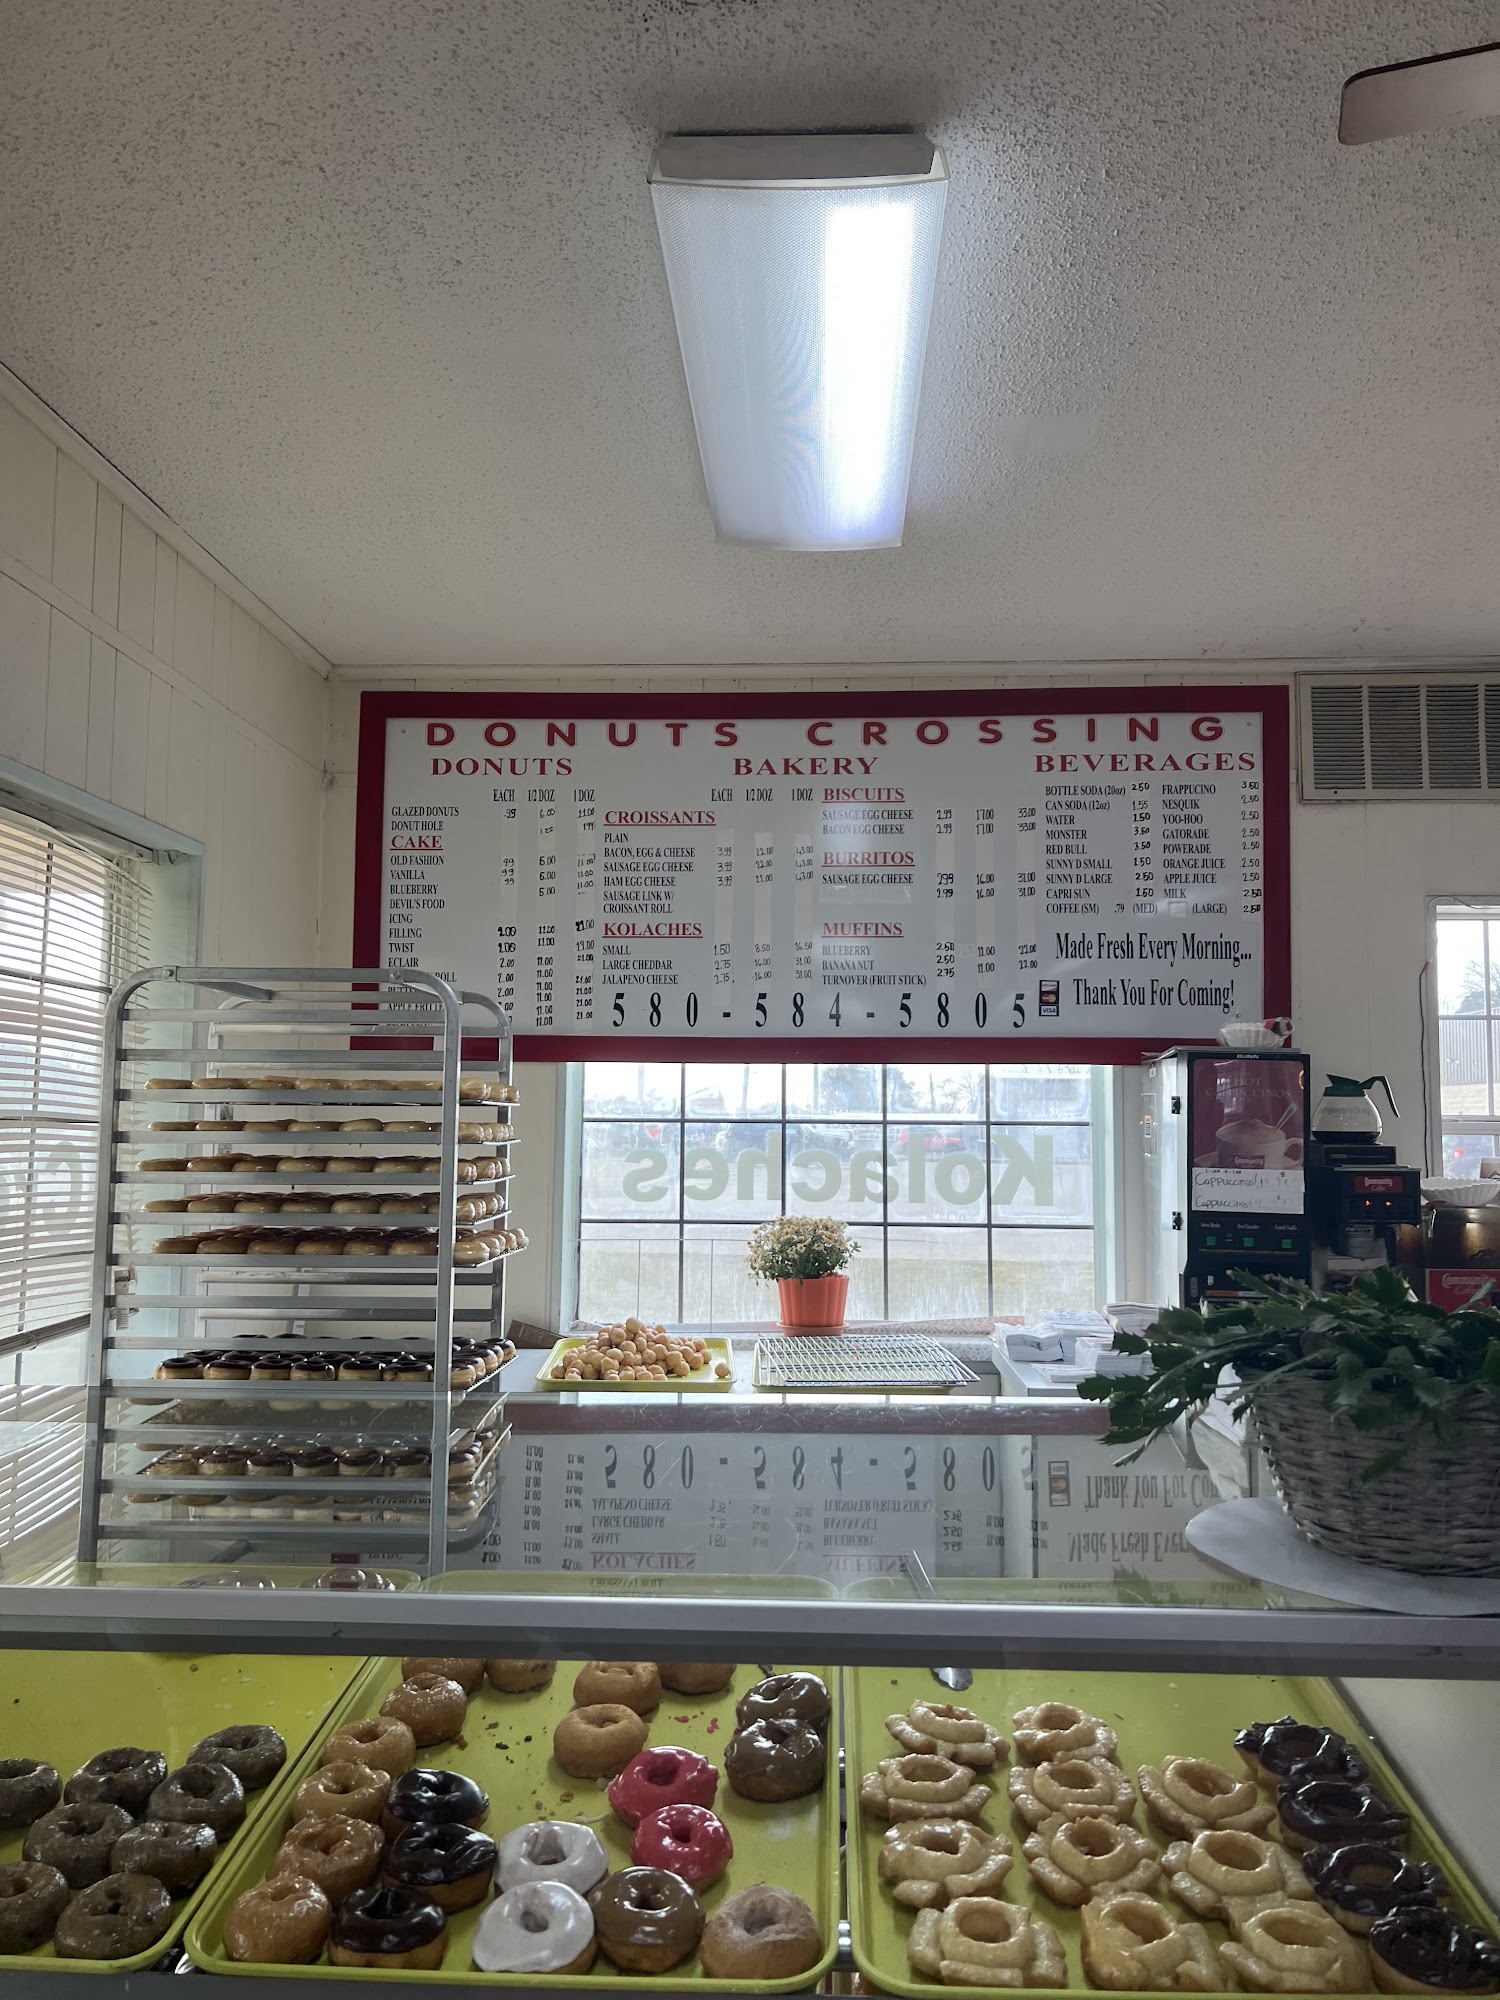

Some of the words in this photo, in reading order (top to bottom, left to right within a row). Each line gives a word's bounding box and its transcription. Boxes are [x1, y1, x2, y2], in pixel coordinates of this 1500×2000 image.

[426, 721, 739, 748] DONUTS
[806, 716, 1225, 746] CROSSING
[431, 758, 572, 776] DONUTS
[733, 757, 879, 777] BAKERY
[1034, 753, 1255, 773] BEVERAGES
[824, 788, 904, 800] BISCUITS
[1046, 786, 1079, 796] BOTTLE
[1081, 786, 1103, 795] SODA
[1162, 784, 1216, 794] FRAPPUCINO
[493, 789, 515, 801] EACH
[528, 789, 537, 801] 1/2
[539, 789, 555, 801] DOZ
[579, 789, 595, 801] DOZ
[712, 789, 733, 801] EACH
[746, 789, 756, 801] 1/2
[757, 789, 773, 801] DOZ
[797, 789, 813, 801] DOZ
[1046, 801, 1063, 810] CAN
[1065, 801, 1087, 810] SODA
[1162, 799, 1200, 811] NESQUIK
[392, 806, 424, 816] GLAZED
[427, 806, 459, 816] DONUTS
[823, 810, 860, 820] SAUSAGE
[862, 810, 880, 820] EGG
[881, 810, 913, 820] CHEESE
[605, 811, 715, 824] CROISSANTS
[1046, 815, 1075, 825] WATER
[1162, 814, 1203, 824] YOO-HOO
[391, 821, 419, 831] DONUT
[421, 821, 444, 831] HOLE
[823, 825, 851, 834] BACON
[853, 825, 871, 834] EGG
[873, 825, 904, 834] CHEESE
[604, 833, 629, 843] PLAIN
[1046, 830, 1087, 840] MONSTER
[1163, 829, 1209, 839] GATORADE
[391, 835, 442, 848] CAKE
[604, 848, 635, 858] BACON,
[636, 848, 654, 857] EGG
[656, 848, 661, 857] &
[664, 848, 695, 857] CHEESE
[1046, 845, 1063, 854] RED
[1065, 845, 1087, 854] BULL
[1163, 844, 1211, 854] POWERADE
[390, 855, 407, 865] OLD
[409, 855, 444, 865] FASHION
[824, 851, 914, 865] BURRITOS
[604, 862, 641, 872] SAUSAGE
[643, 862, 660, 872] EGG
[662, 862, 693, 872] CHEESE
[1046, 859, 1074, 869] SUNNY
[1076, 859, 1082, 869] D
[1084, 859, 1113, 869] SMALL
[1163, 859, 1199, 869] ORANGE
[1200, 859, 1226, 869] JUICE
[391, 870, 425, 880] VANILLA
[822, 874, 860, 884] SAUSAGE
[862, 874, 879, 884] EGG
[881, 874, 913, 884] CHEESE
[1046, 874, 1074, 884] SUNNY
[1076, 874, 1082, 884] D
[1084, 874, 1113, 884] LARGE
[1163, 874, 1191, 884] APPLE
[1192, 874, 1217, 884] JUICE
[604, 877, 623, 886] HAM
[625, 877, 642, 886] EGG
[644, 877, 675, 886] CHEESE
[390, 885, 438, 894] BLUEBERRY
[1046, 889, 1072, 899] CAPRI
[1074, 889, 1090, 898] SUN
[1164, 889, 1186, 898] MILK
[603, 891, 641, 901] SAUSAGE
[642, 891, 662, 901] LINK
[390, 899, 420, 909] DEVIL'S
[422, 899, 445, 909] FOOD
[604, 904, 650, 914] CROISSANT
[652, 904, 673, 914] ROLL
[1047, 903, 1080, 913] COFFEE
[1081, 903, 1099, 915] (SM)
[1133, 903, 1157, 914] (MED)
[1193, 903, 1227, 914] (LARGE)
[389, 914, 413, 924] ICING
[389, 928, 422, 938] FILLING
[604, 923, 702, 936] KOLACHES
[823, 922, 903, 936] MUFFINS
[389, 943, 414, 953] TWIST
[603, 945, 631, 955] SMALL
[822, 946, 871, 955] BLUEBERRY
[1056, 933, 1093, 959] Made
[1097, 933, 1134, 959] Fresh
[1139, 933, 1178, 967] Every
[1182, 933, 1251, 967] Morning...
[388, 958, 419, 968] ECLAIR
[602, 960, 630, 970] LARGE
[632, 960, 672, 970] CHEDDAR
[822, 960, 857, 970] BANANA
[857, 960, 874, 970] NUT
[602, 975, 645, 984] JALAPENO
[646, 975, 678, 984] CHEESE
[822, 975, 869, 985] TURNOVER
[869, 975, 897, 987] (FRUIT
[898, 975, 926, 986] STICK)
[1073, 979, 1117, 1006] Thank
[1120, 979, 1145, 1006] You
[1150, 979, 1173, 1006] For
[1178, 979, 1234, 1014] Coming!
